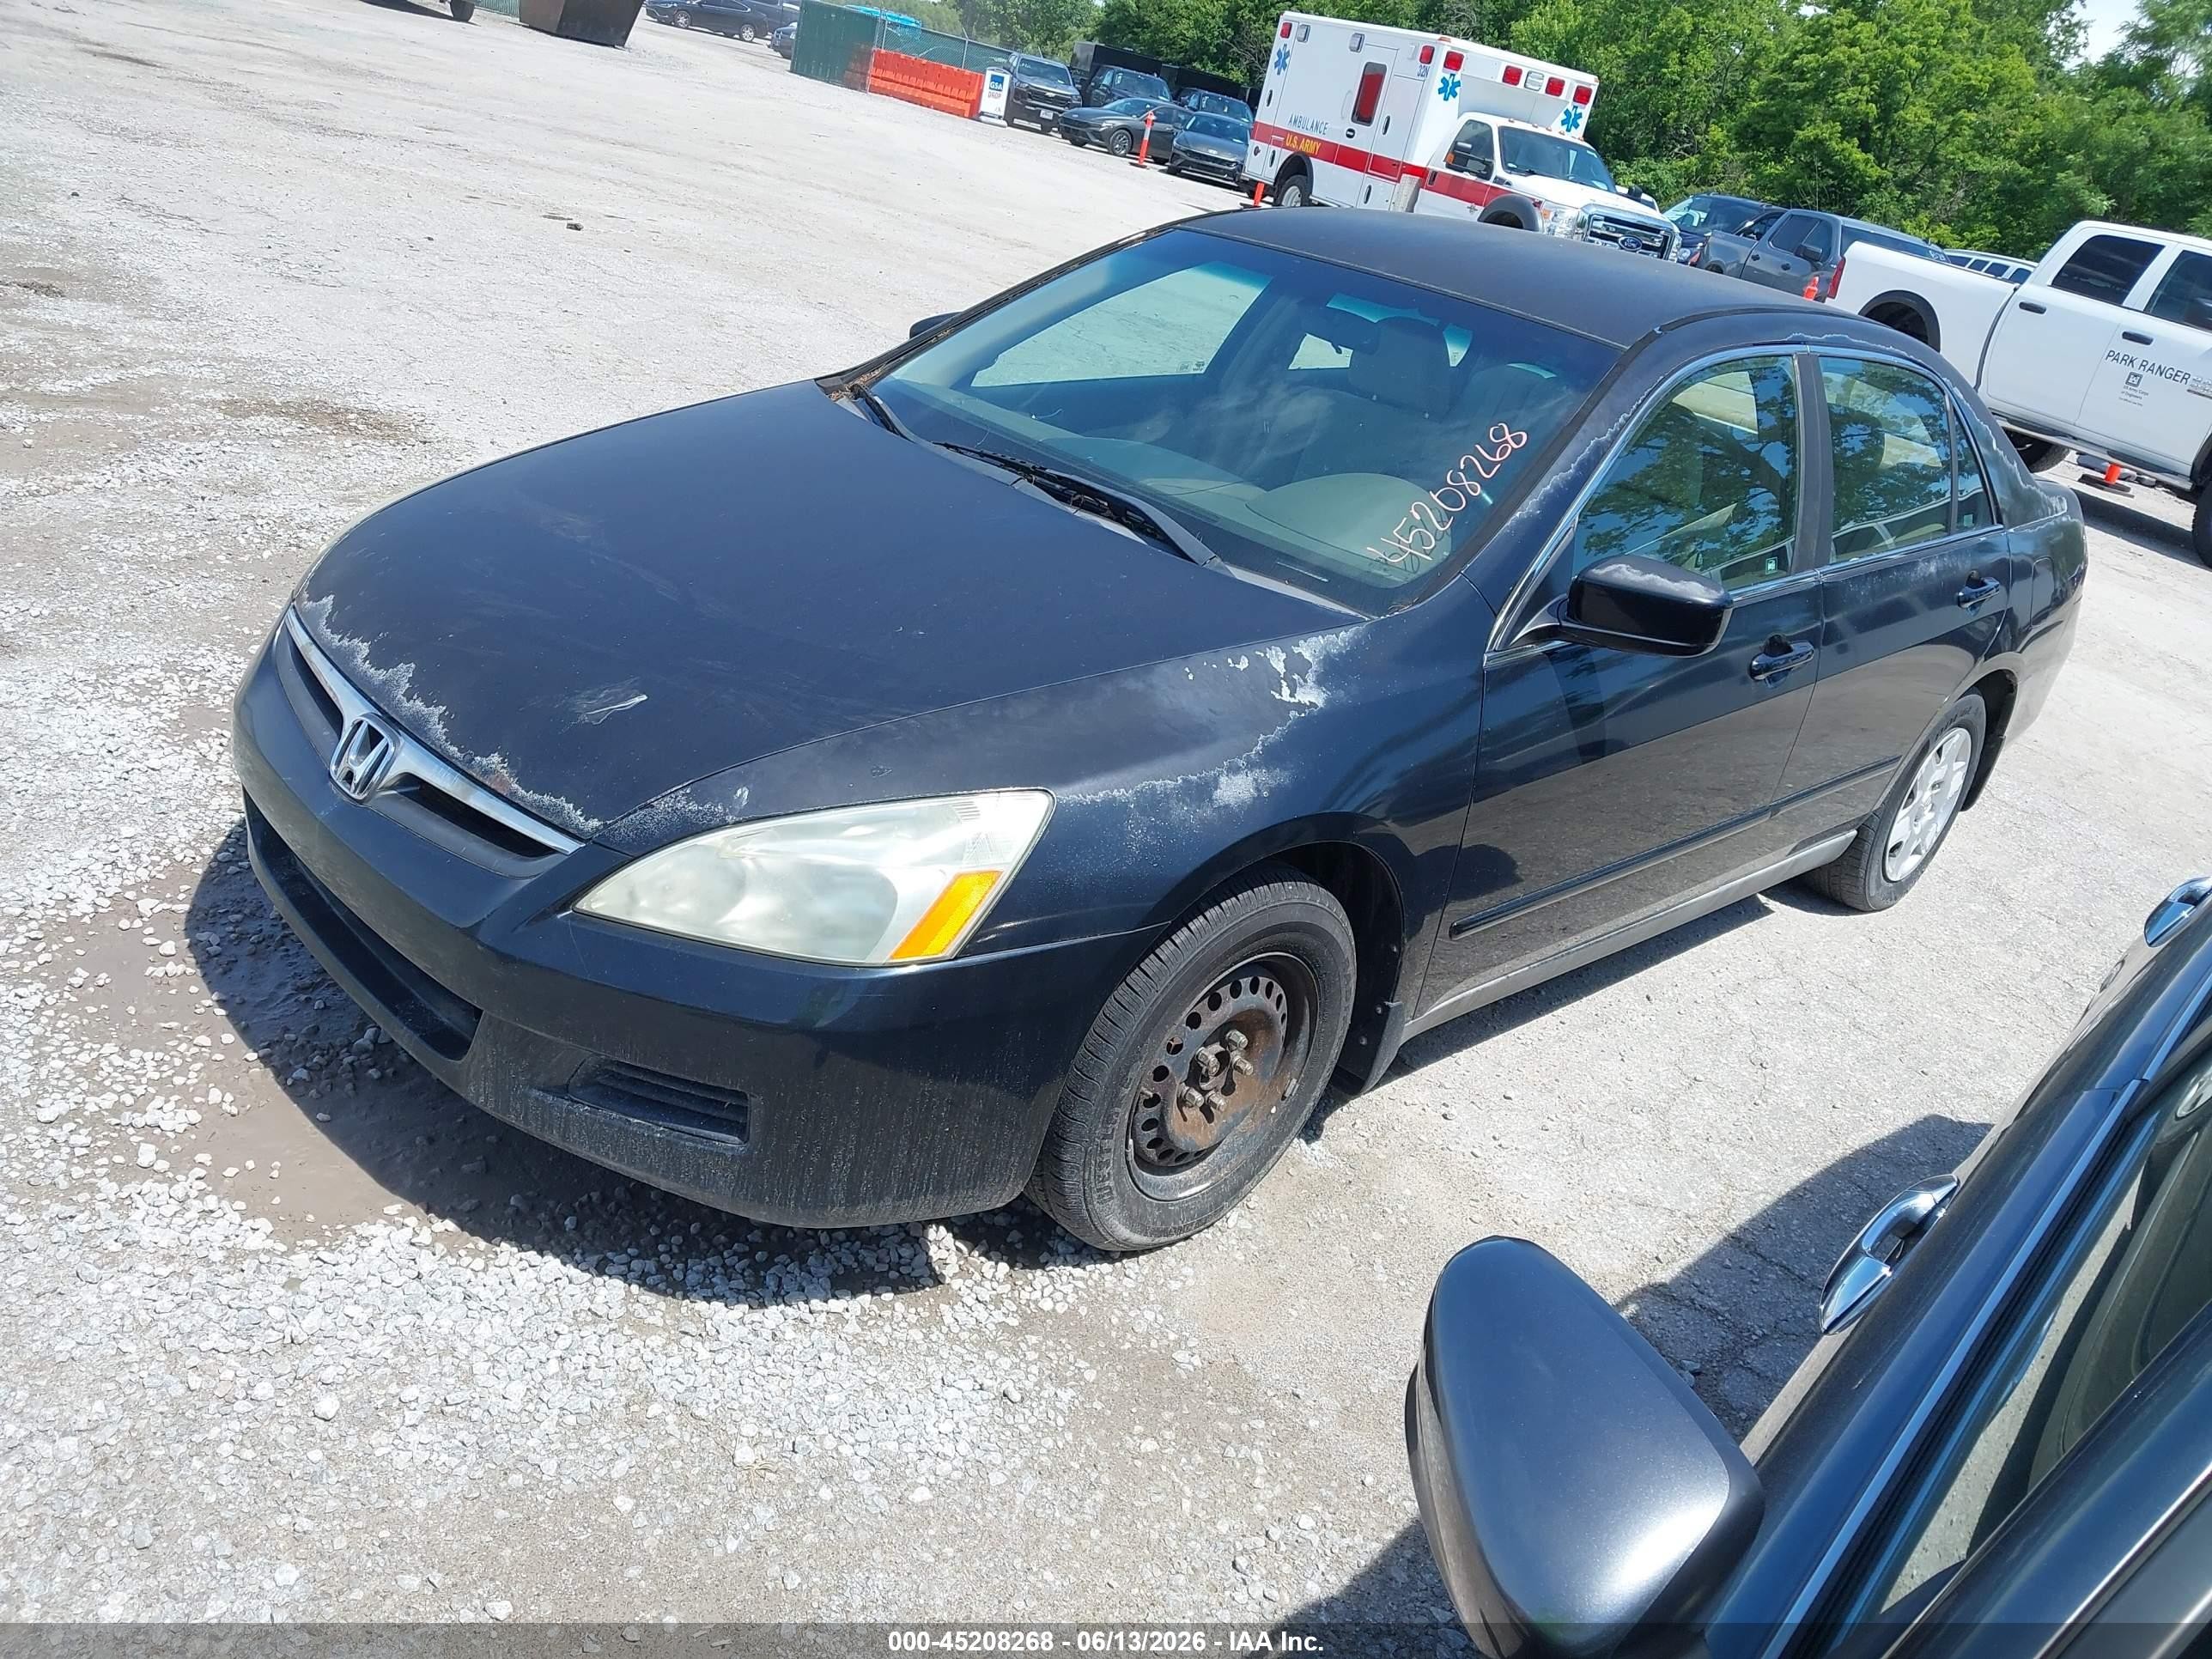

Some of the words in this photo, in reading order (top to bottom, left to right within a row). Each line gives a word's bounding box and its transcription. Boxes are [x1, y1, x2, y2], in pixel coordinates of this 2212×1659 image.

[990, 82, 1003, 90] GSA
[1288, 113, 1328, 135] AMBULANCE
[1285, 133, 1298, 151] U.S.
[1298, 137, 1322, 155] ARMY
[2105, 349, 2138, 368] PARK
[2138, 359, 2191, 386] RANGER
[1367, 422, 1528, 562] 45208268
